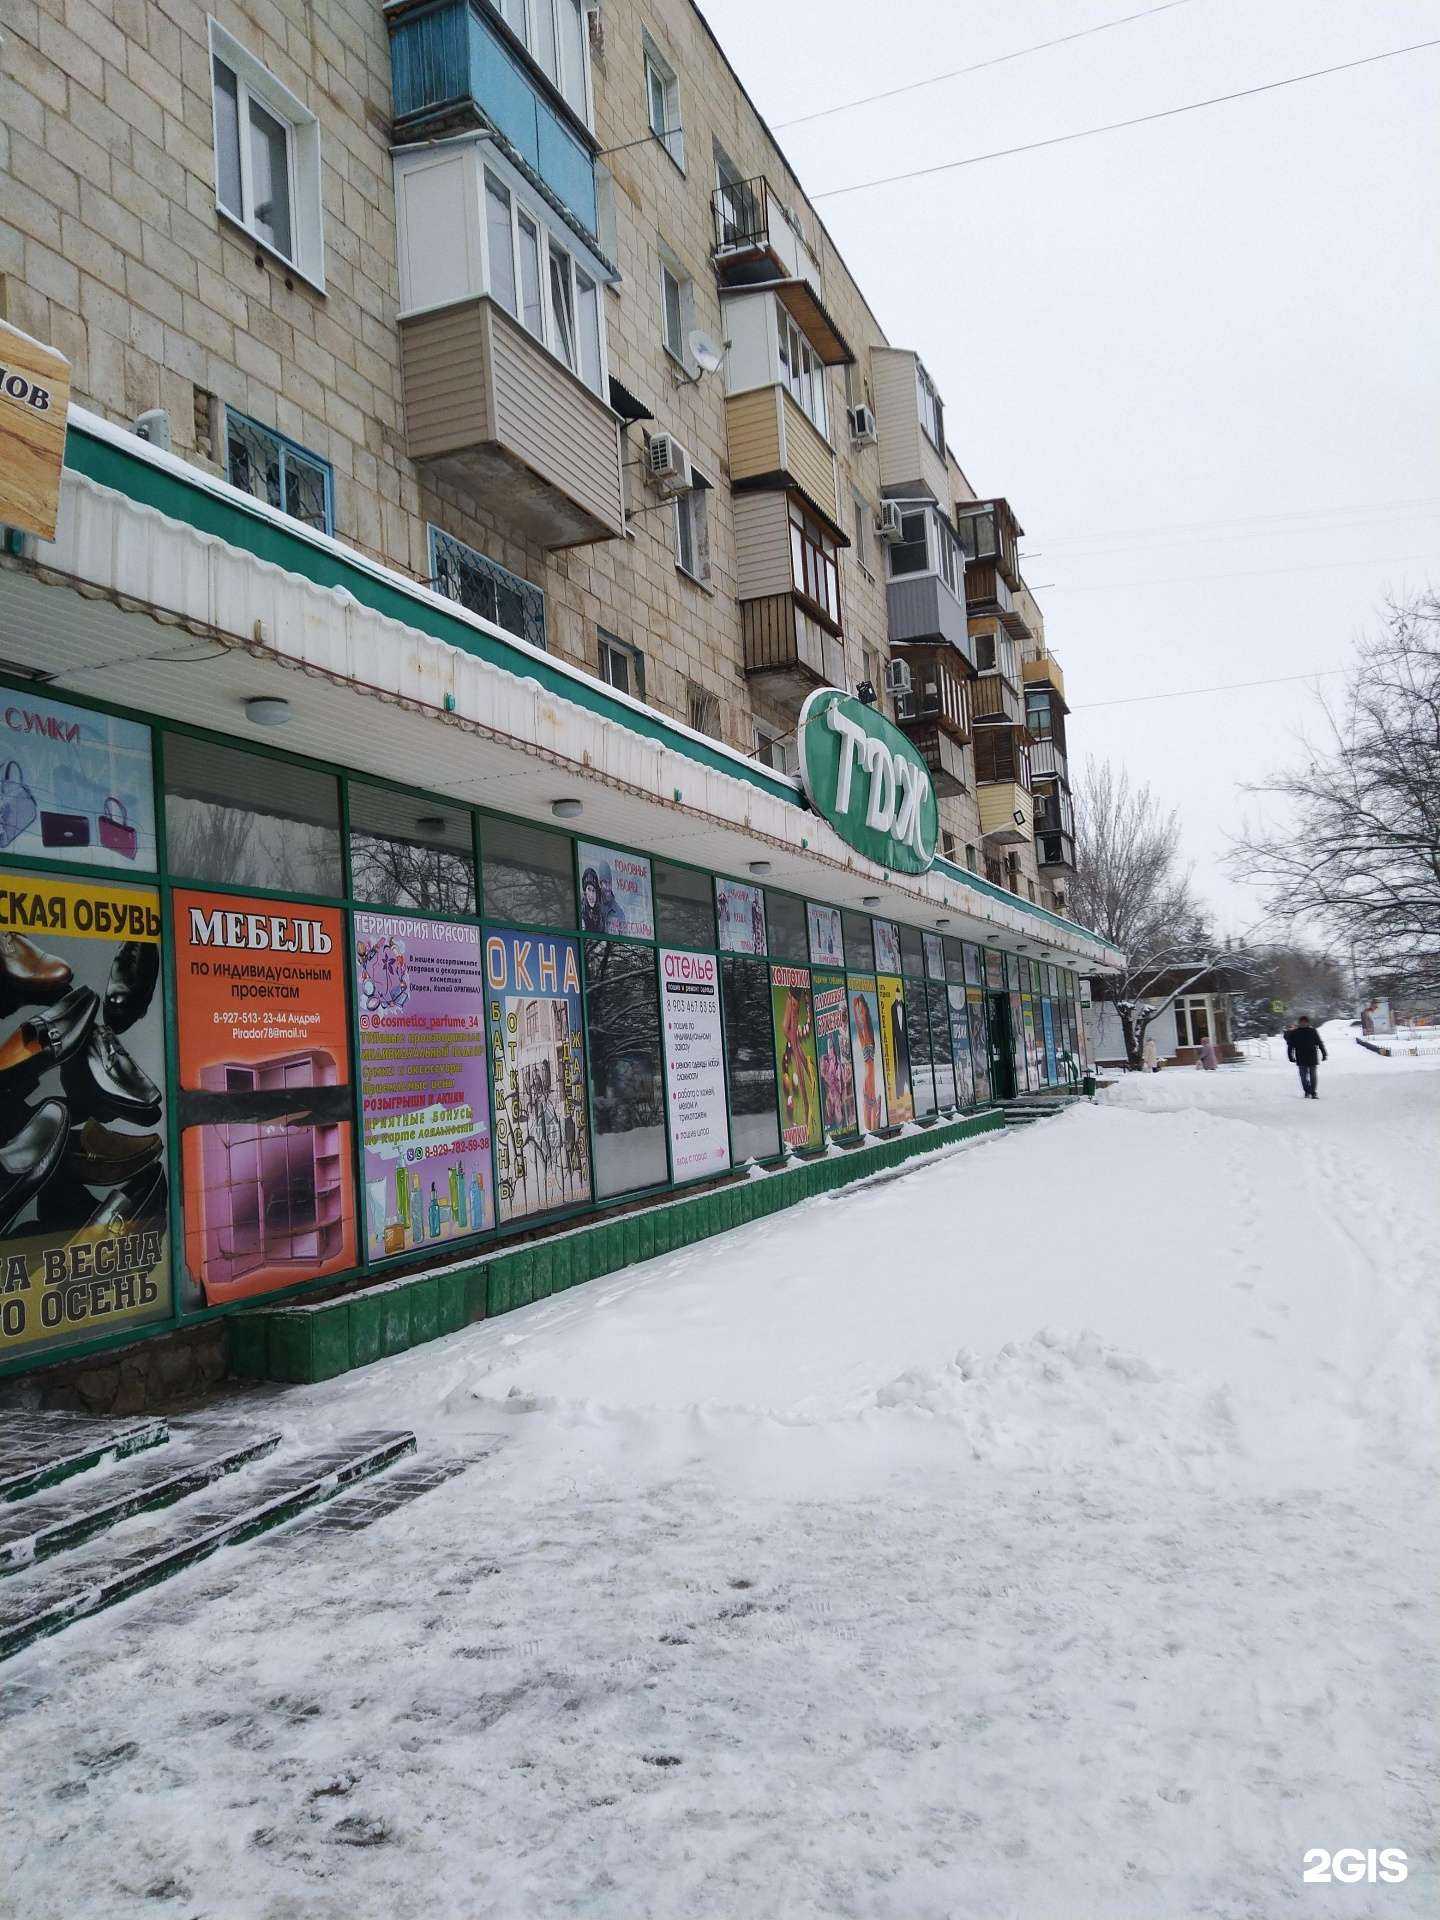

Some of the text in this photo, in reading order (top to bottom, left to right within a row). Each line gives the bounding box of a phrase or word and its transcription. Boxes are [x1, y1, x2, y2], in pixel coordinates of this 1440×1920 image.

[4, 706, 81, 745] СУМКИ
[74, 899, 161, 937] ОБУВЬ
[188, 906, 332, 954] МЕБЕЛЬ
[354, 914, 479, 944] ТЕРРИТОРИЯ КРАСОТЫ
[213, 963, 332, 981] индивидуальным
[486, 936, 580, 994] ОКНА
[664, 954, 714, 981] ателье
[231, 983, 300, 1000] проектам
[288, 1012, 321, 1026] Андрей
[364, 1094, 426, 1112] РОЗЫГРЫШИ
[364, 1106, 473, 1131] ПРИЯТНЫЕ БОНУСЫ
[0, 1231, 163, 1295] А ВЕСНА
[40, 1271, 159, 1329] ОСЕНЬ
